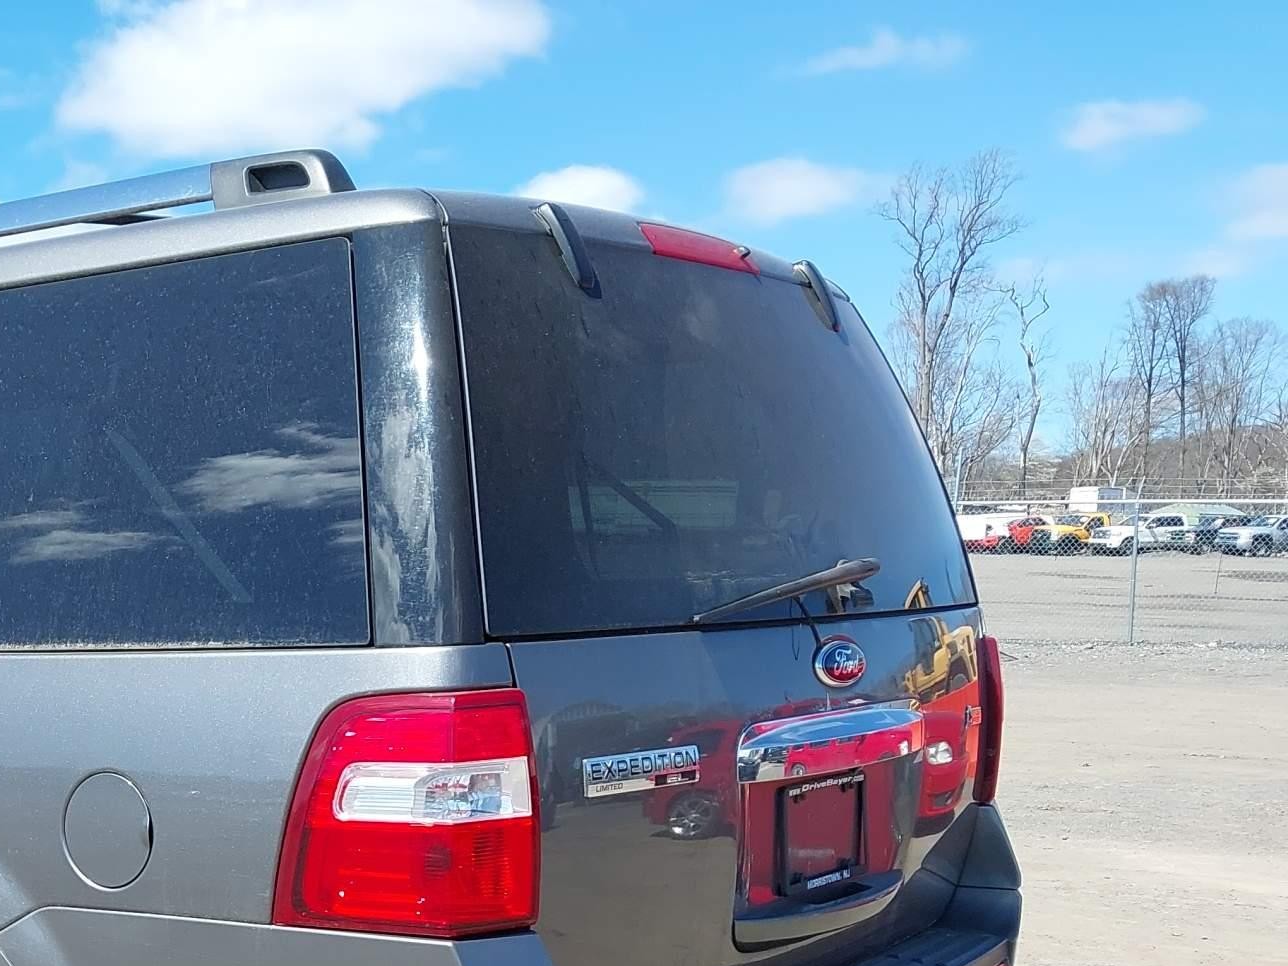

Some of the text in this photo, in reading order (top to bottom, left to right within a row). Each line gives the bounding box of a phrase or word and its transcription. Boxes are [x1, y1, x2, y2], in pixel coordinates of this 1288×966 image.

[834, 648, 860, 676] Ford
[591, 749, 697, 781] EXPEDITION
[595, 783, 624, 793] LIMITED
